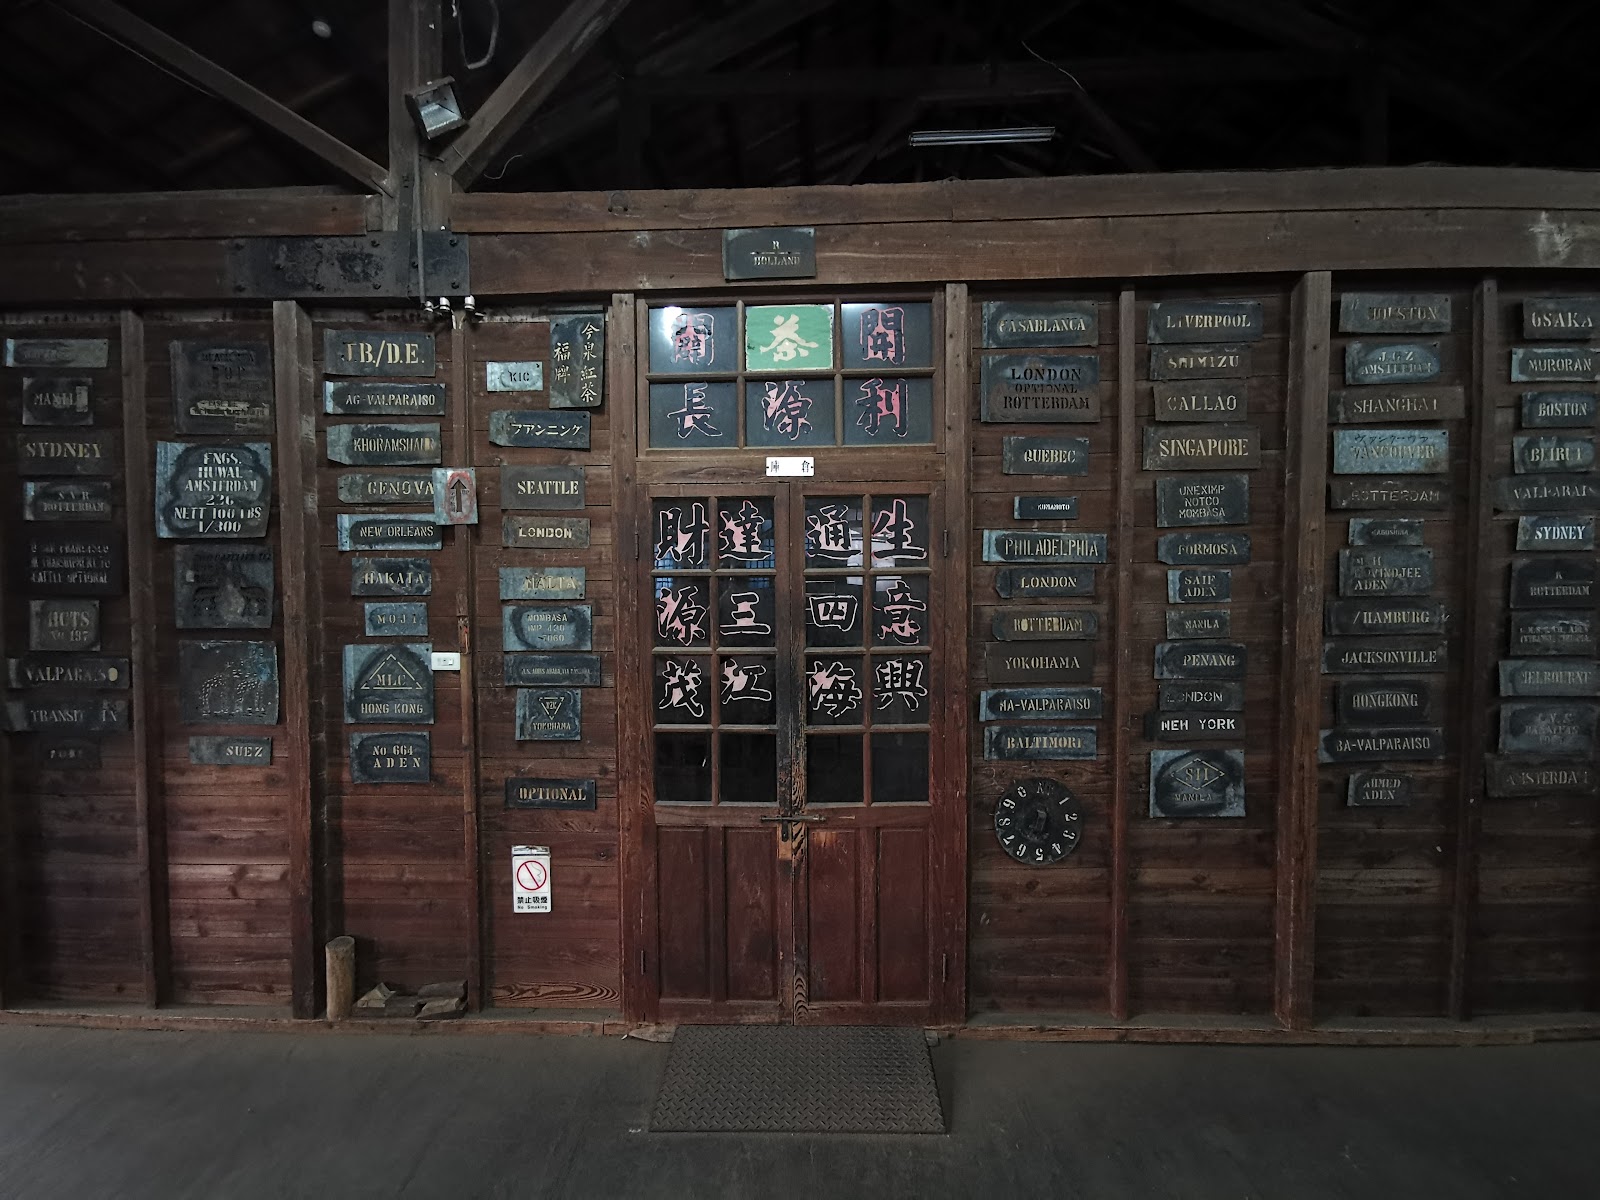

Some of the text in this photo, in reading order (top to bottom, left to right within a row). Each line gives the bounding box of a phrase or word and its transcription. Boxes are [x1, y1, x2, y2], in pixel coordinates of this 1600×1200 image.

[753, 255, 801, 266] HOLLAND
[999, 318, 1087, 333] CASABLANCA
[1166, 314, 1251, 329] LIVERPOOL
[1531, 311, 1593, 328] OSAKA
[1528, 358, 1592, 372] MURORAN
[1010, 368, 1082, 381] LONDON
[1014, 383, 1078, 394] OPTIONAL
[1003, 396, 1090, 410] ROTTERDAM
[1167, 394, 1238, 411] CALLAO
[1538, 402, 1588, 417] BOSTON
[26, 442, 102, 459] SYDNEY
[1159, 438, 1249, 457] SINGAPORE
[1023, 449, 1078, 464] QUEBEC
[367, 480, 435, 496] GENOVA
[517, 480, 579, 495] SEATTLE
[1179, 484, 1226, 496] UNEXIMP
[1179, 508, 1226, 519] MOMBASA
[360, 525, 434, 538] NEW ORLEANS
[518, 527, 574, 539] LONDON
[1534, 525, 1586, 540] SYDNEY
[1005, 538, 1099, 557] PHILADELPHIA
[1178, 543, 1238, 556] FORMOSA
[364, 572, 426, 585] HAKATA
[1021, 576, 1078, 589] LONDON
[1004, 656, 1081, 670] YOKOHAMA
[1182, 654, 1236, 667] PENANG
[1341, 650, 1437, 664] JACKSONVILLE
[24, 666, 119, 682] VALPARASO
[1352, 692, 1419, 708] HONGKONG
[361, 703, 424, 715] HONG KONG
[1199, 718, 1236, 730] YORK
[225, 745, 263, 758] SUEZ
[392, 744, 415, 756] 664
[373, 757, 421, 768] ADEN
[519, 786, 587, 801] OPTIONAL
